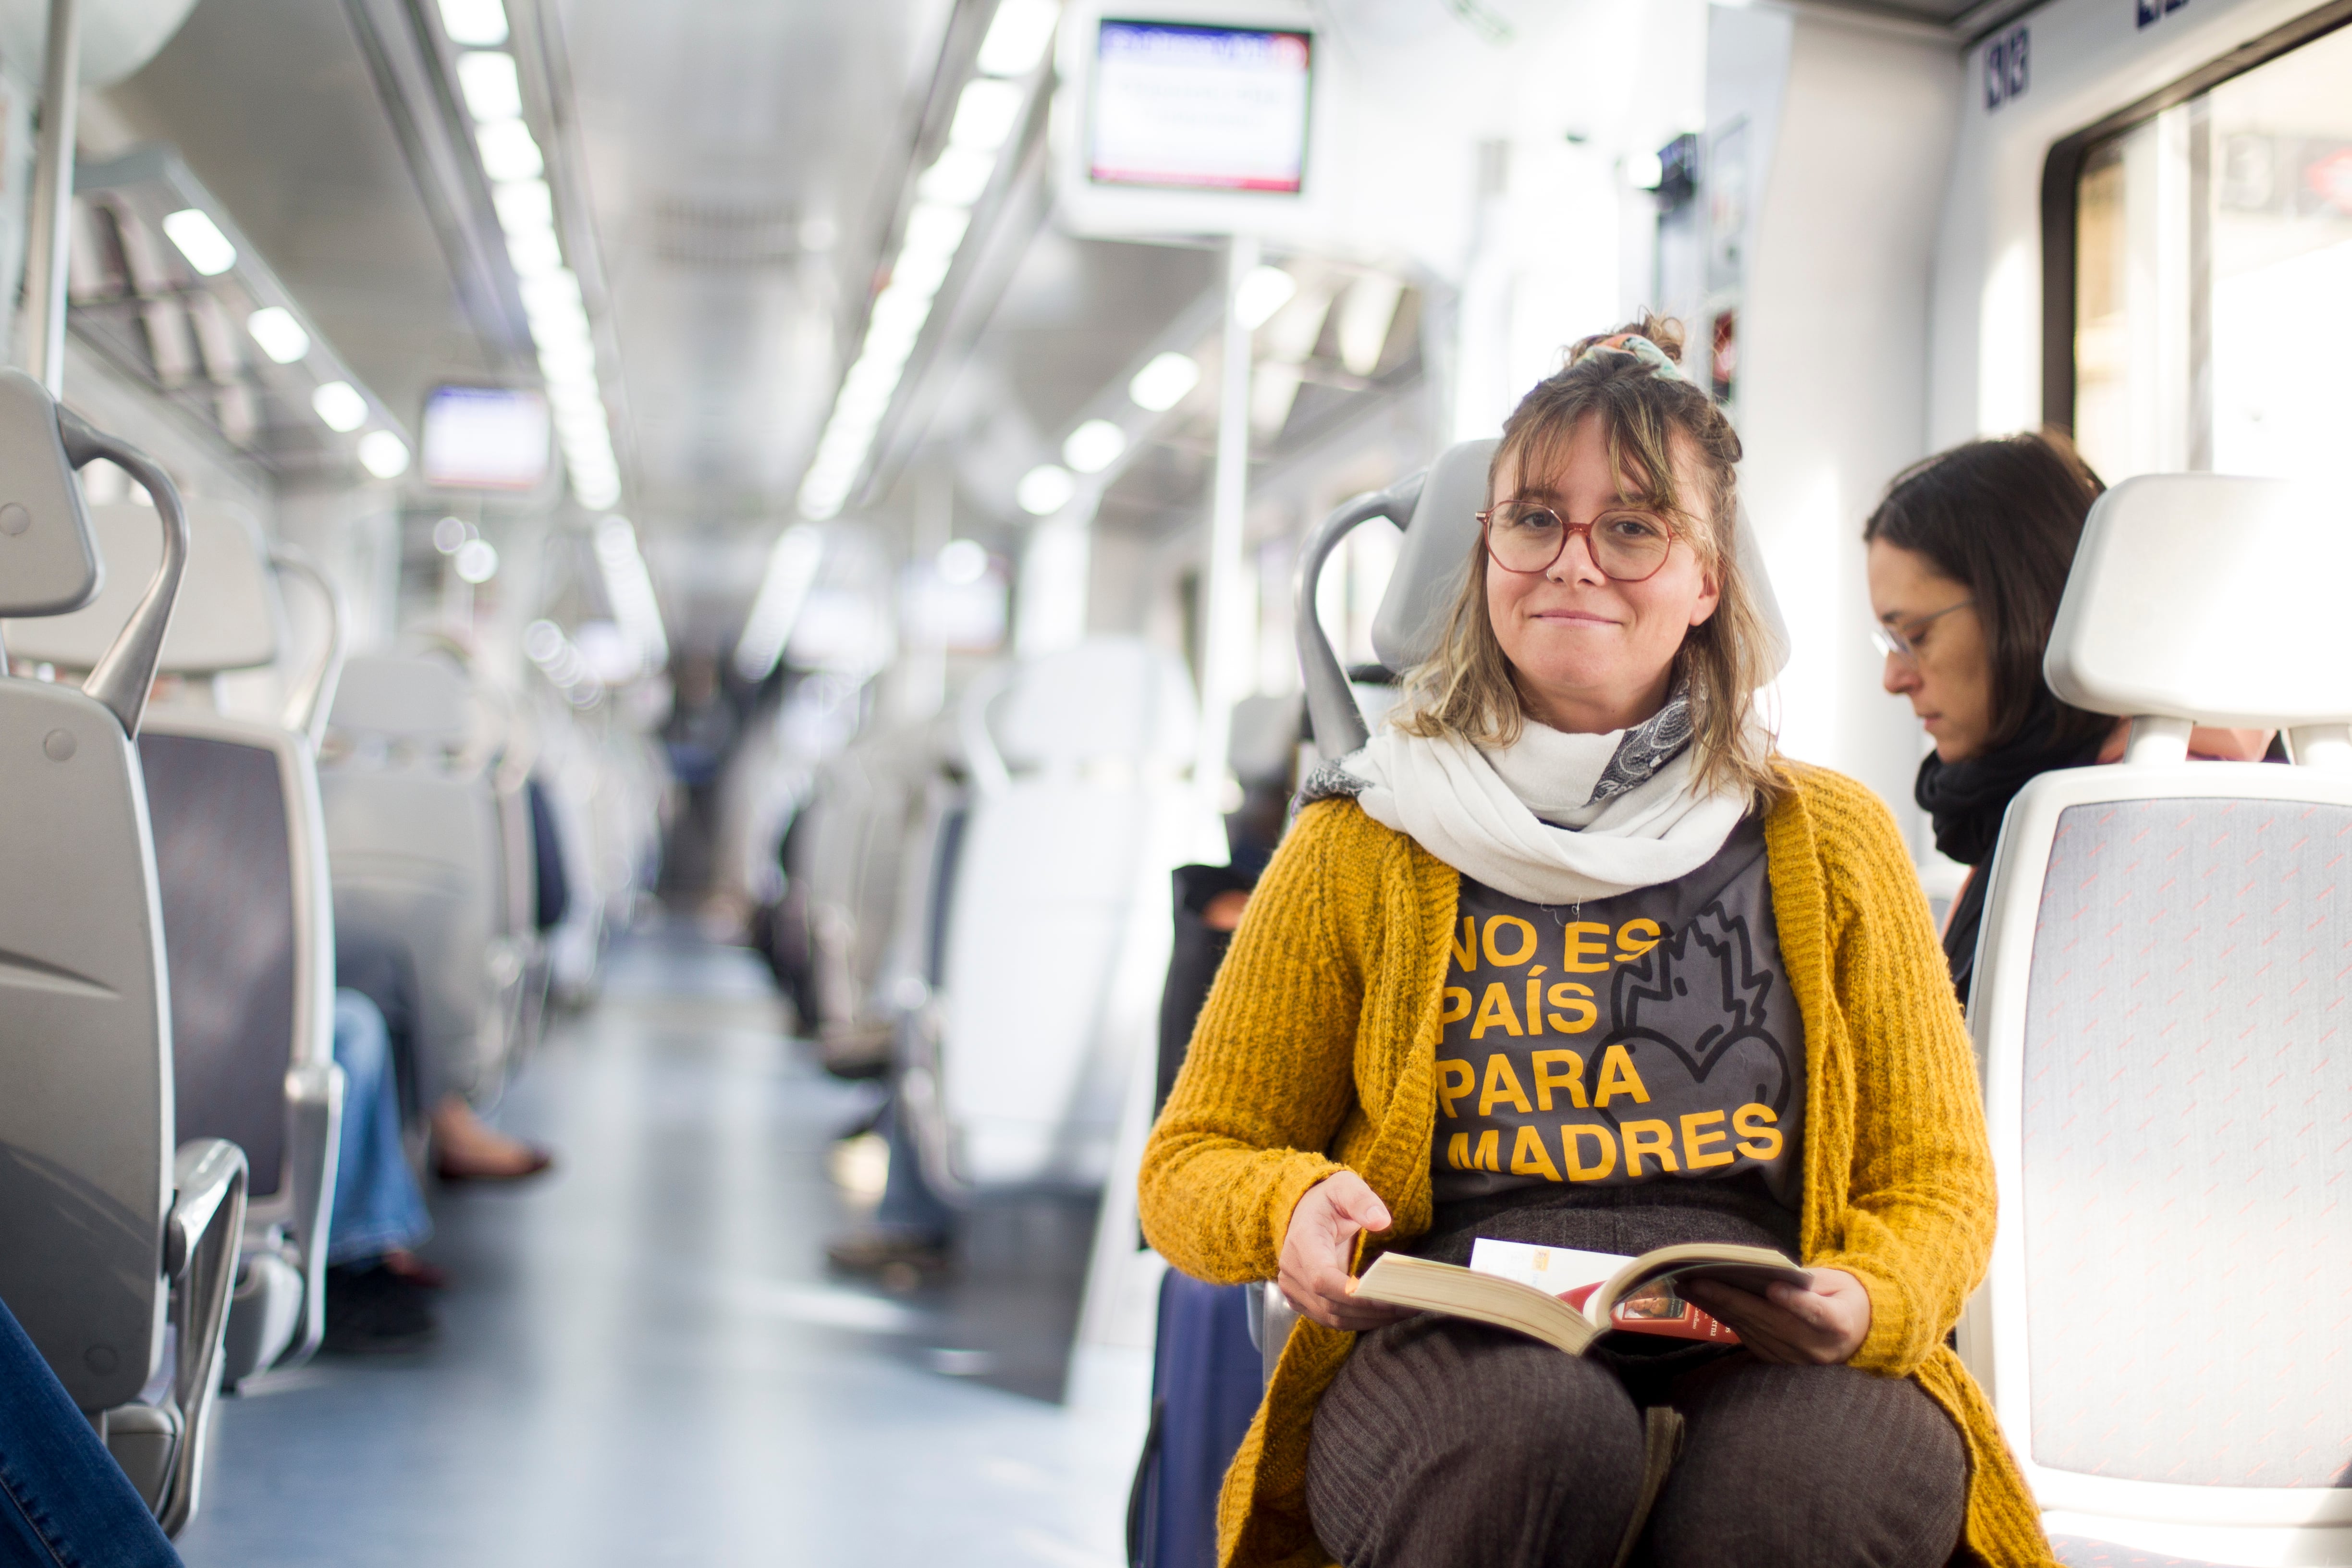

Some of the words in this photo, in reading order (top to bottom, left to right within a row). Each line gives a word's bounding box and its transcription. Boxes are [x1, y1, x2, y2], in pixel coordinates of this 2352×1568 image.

[1451, 915, 1538, 972] NO
[1564, 918, 1661, 973] ES
[1435, 965, 1598, 1045] PAÍS
[1435, 1045, 1651, 1118] PARA
[1447, 1102, 1784, 1182] MADRES
